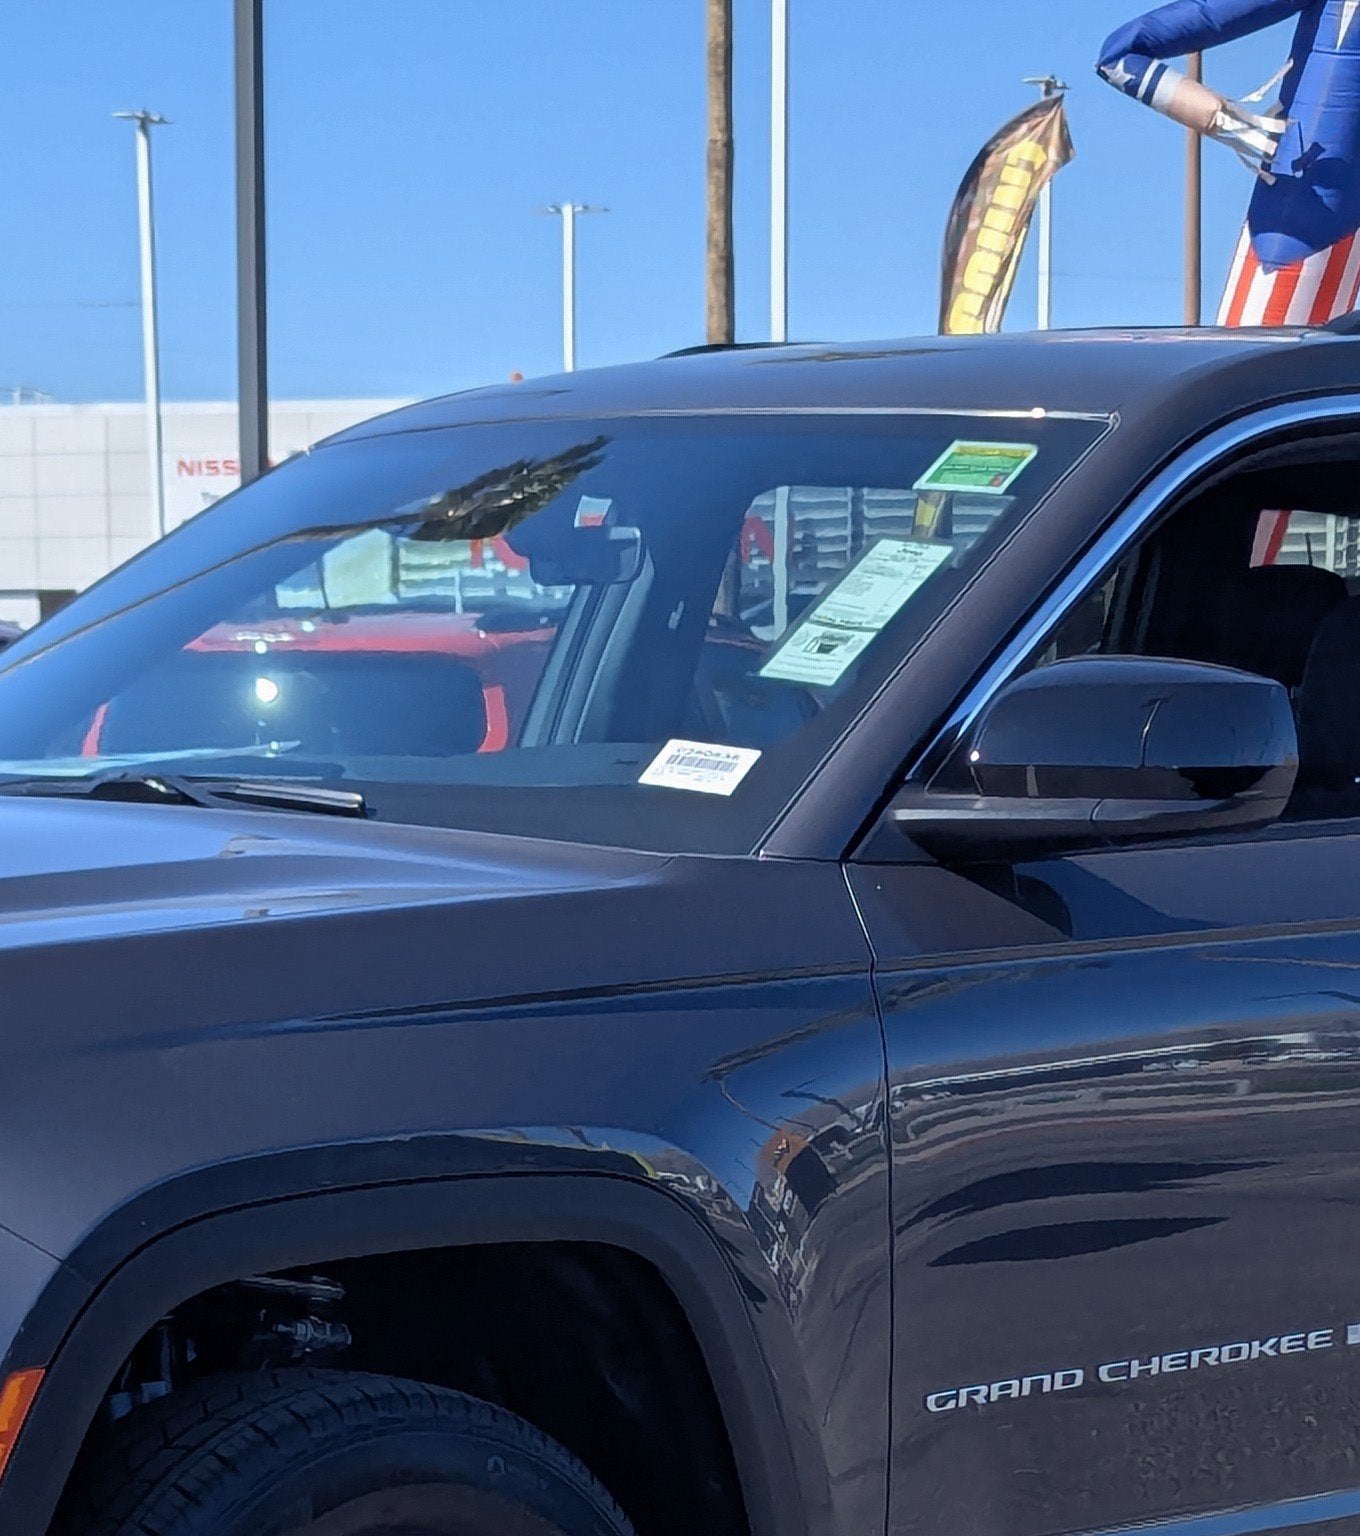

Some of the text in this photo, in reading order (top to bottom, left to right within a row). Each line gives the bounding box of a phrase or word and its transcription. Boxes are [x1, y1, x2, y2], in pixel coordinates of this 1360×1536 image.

[176, 459, 274, 477] NISS
[926, 1329, 1333, 1413] GRAND CHEROKEE
